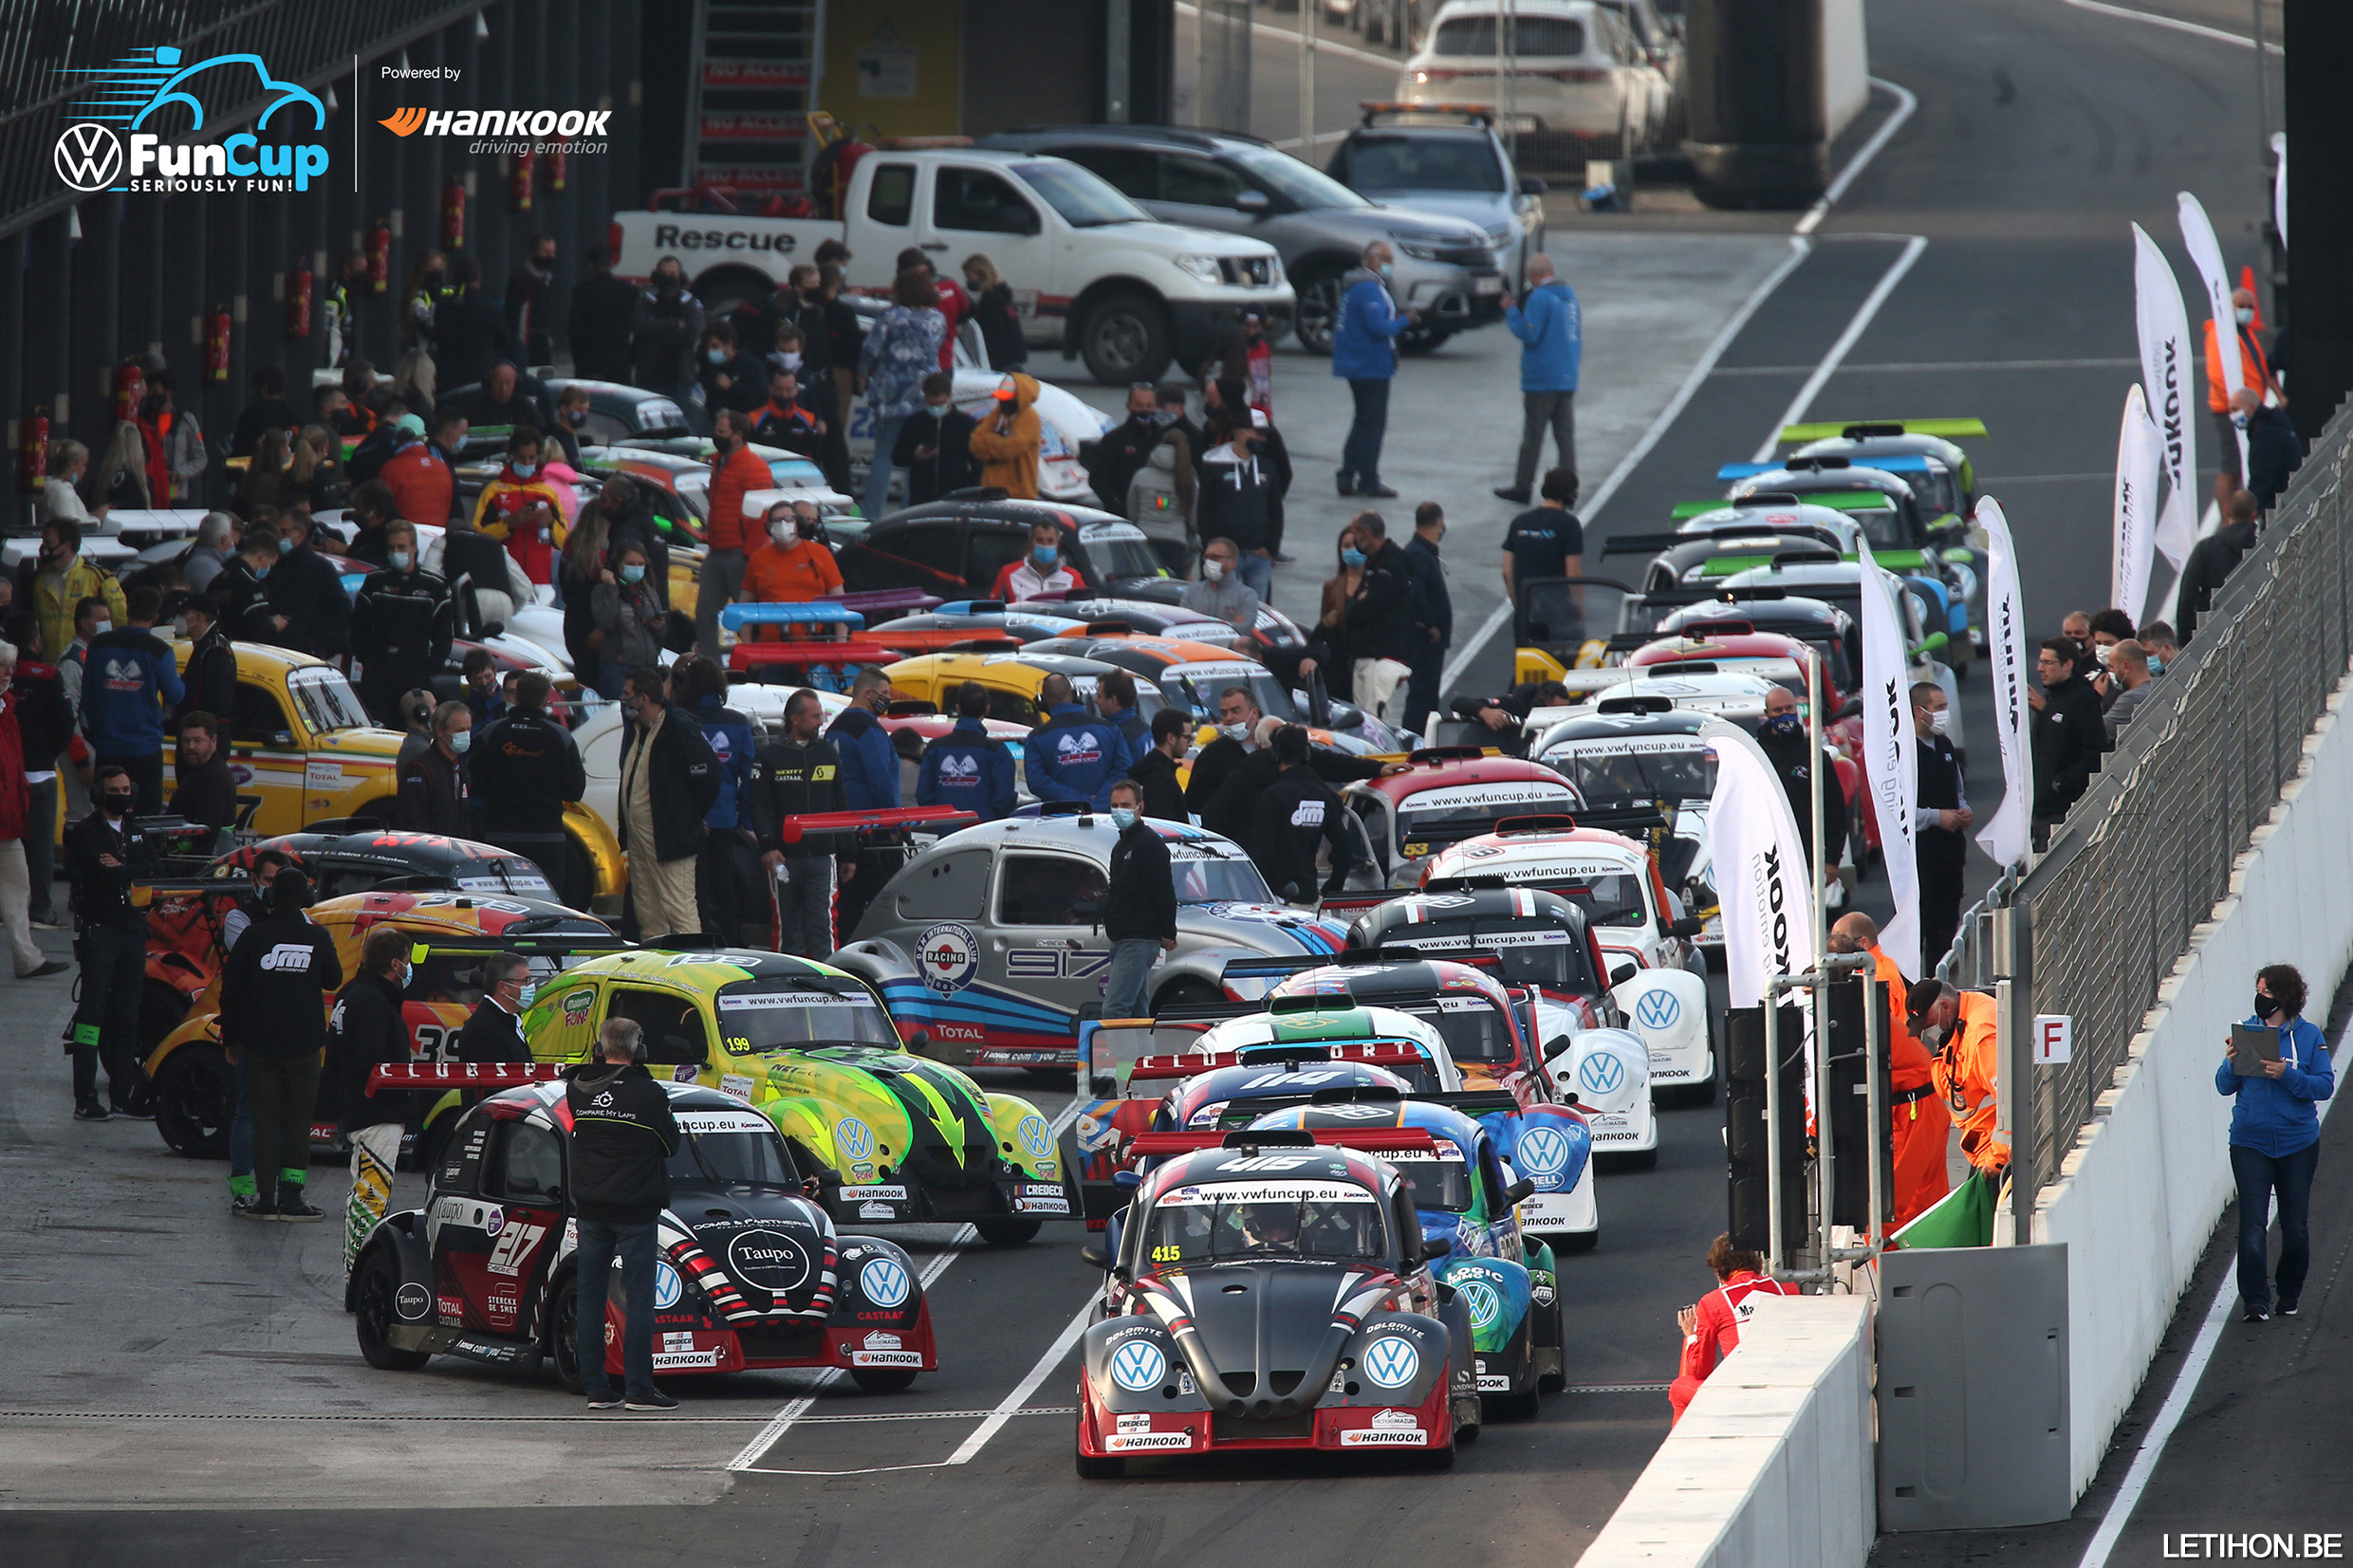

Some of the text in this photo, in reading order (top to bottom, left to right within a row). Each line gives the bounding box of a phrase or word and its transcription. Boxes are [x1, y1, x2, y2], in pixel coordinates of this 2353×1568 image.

[655, 223, 797, 252] Rescue
[1575, 742, 1685, 755] www.vwfuncup.eu
[309, 771, 339, 782] TOTAL
[1431, 790, 1543, 806] www.vwfuncup.eu
[1403, 842, 1429, 856] 53
[1417, 933, 1535, 950] www.vwfuncup.eu
[927, 951, 964, 963] RACING
[966, 939, 978, 963] CLUB
[665, 953, 764, 968] 199
[1006, 948, 1112, 978] 917
[747, 993, 844, 1007] www.vwfuncup.eu
[565, 1008, 589, 1028] FUN!
[936, 1024, 984, 1039] TOTAL
[726, 1036, 750, 1052] 199
[2044, 1022, 2064, 1058] F
[380, 1062, 565, 1079] CLUBSPO
[762, 1063, 797, 1074] NET
[1650, 1069, 1691, 1079] ANKOOK
[1239, 1071, 1348, 1090] 114
[723, 1085, 749, 1098] TOTAL
[676, 1119, 736, 1133] uncup.eu
[1214, 1154, 1324, 1172] 415
[1529, 1174, 1559, 1185] BELL
[858, 1189, 903, 1198] HANKOOK
[1026, 1185, 1064, 1196] CREDECO
[1199, 1187, 1338, 1203] www.vwfuncup.eu
[1343, 1190, 1369, 1199] KRONOS
[1030, 1200, 1068, 1211] HANKOOK
[743, 1218, 812, 1228] PARTNERS
[1521, 1217, 1566, 1227] ANKOOK
[565, 1229, 580, 1240] TOT
[489, 1220, 547, 1269] 217
[737, 1246, 794, 1264] Taupo
[1151, 1245, 1181, 1262] 415
[1446, 1266, 1504, 1283] LOGIC
[398, 1296, 424, 1308] Taupo
[436, 1298, 463, 1316] TOTAL
[488, 1295, 518, 1306] STERCKX
[489, 1304, 518, 1315] DE SMET
[654, 1314, 698, 1324] ASTAAR.
[1104, 1326, 1164, 1346] DOLOMITE
[1365, 1321, 1425, 1339] DOLOMITE
[664, 1337, 693, 1346] CREDECO
[655, 1354, 712, 1365] HANKOOK
[871, 1354, 919, 1364] HANKOOK
[1477, 1379, 1505, 1388] KOOK
[1125, 1436, 1187, 1448] HANKOOK
[1362, 1432, 1423, 1442] HANKOOK
